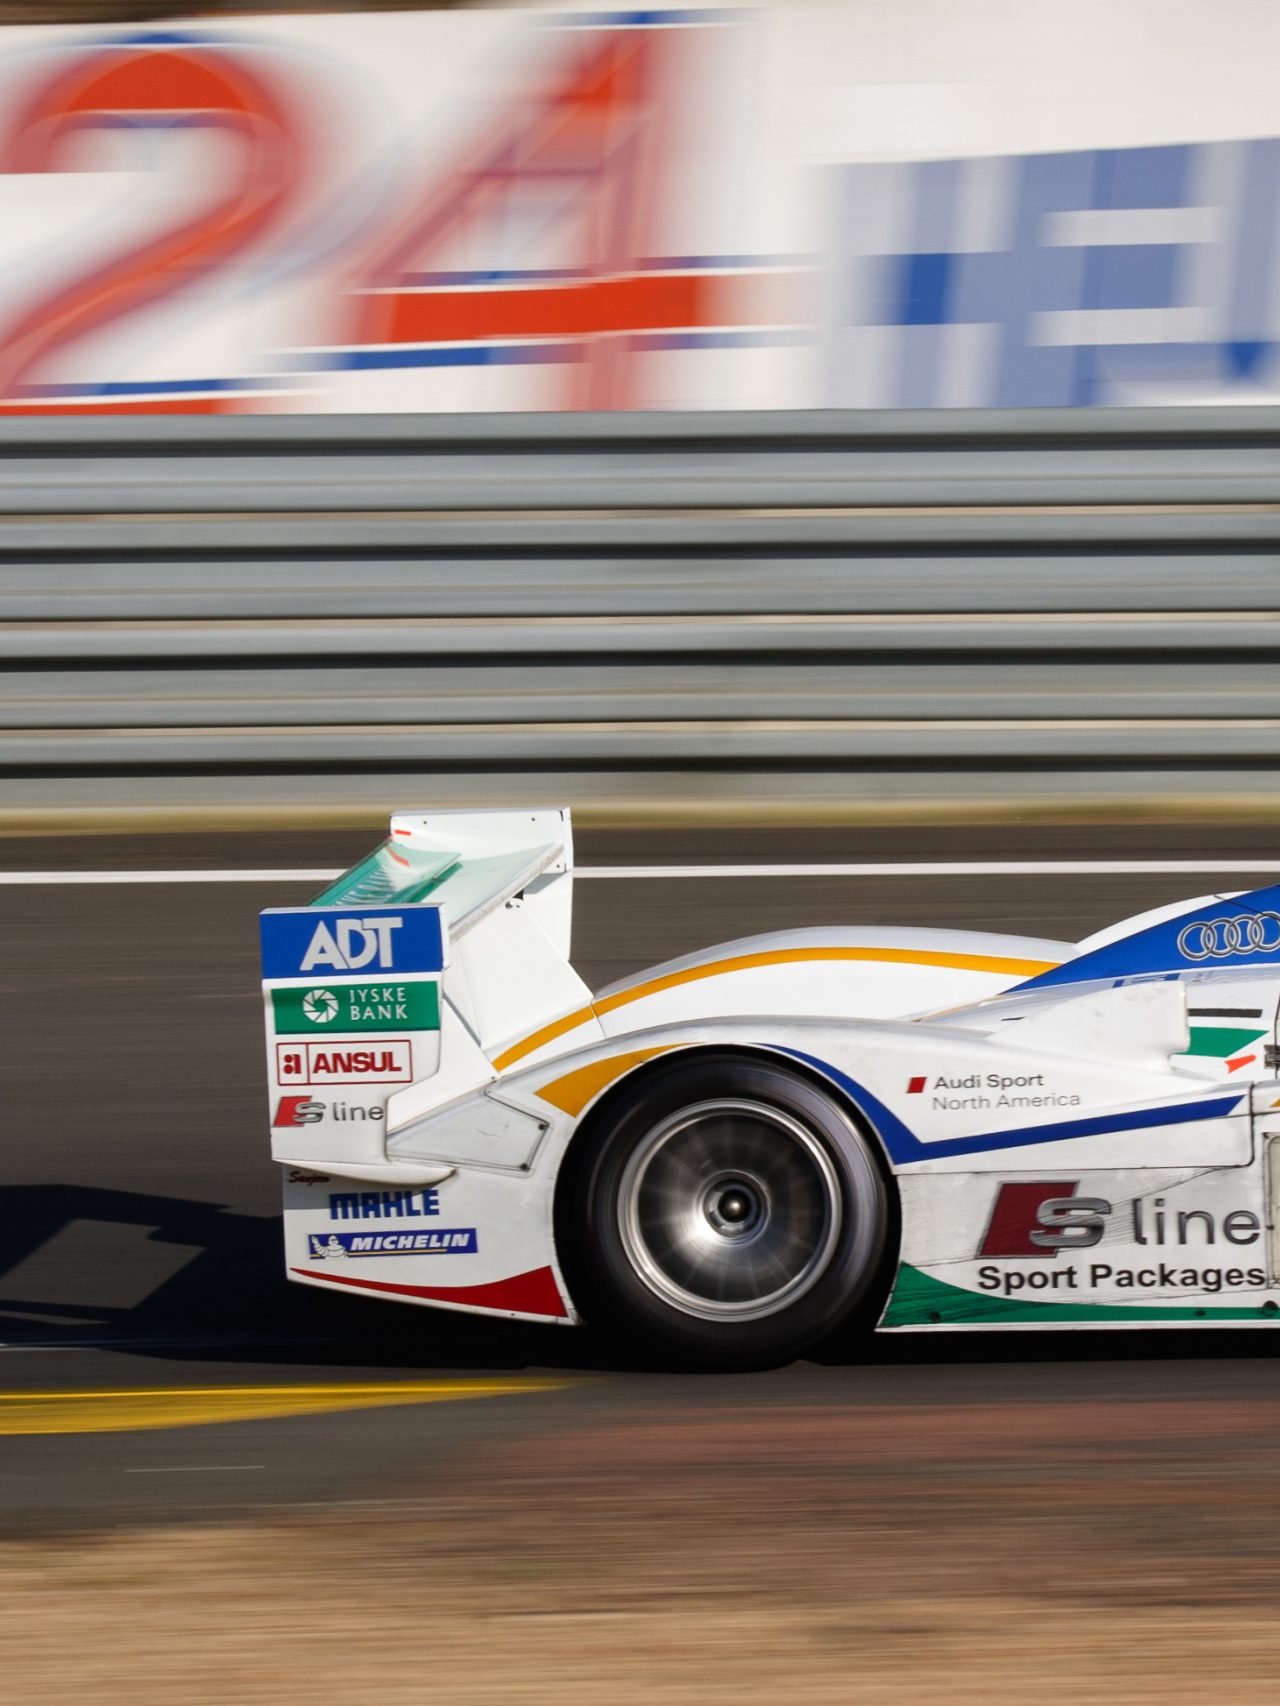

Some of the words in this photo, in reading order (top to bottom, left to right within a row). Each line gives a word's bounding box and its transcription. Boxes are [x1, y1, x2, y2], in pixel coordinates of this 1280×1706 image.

[300, 917, 403, 971] ADT
[350, 987, 406, 1003] JYSKE
[351, 1004, 408, 1020] BANK
[312, 1051, 402, 1074] ANSUL
[934, 1075, 981, 1090] Audi
[986, 1074, 1044, 1090] Sport
[332, 1102, 384, 1122] line
[932, 1095, 991, 1111] North
[996, 1093, 1081, 1109] America
[329, 1189, 440, 1220] MAHLE
[1132, 1198, 1261, 1246] line
[350, 1233, 471, 1251] MICHELIN
[978, 1265, 1077, 1296] Sport
[1090, 1263, 1266, 1292] Packages
